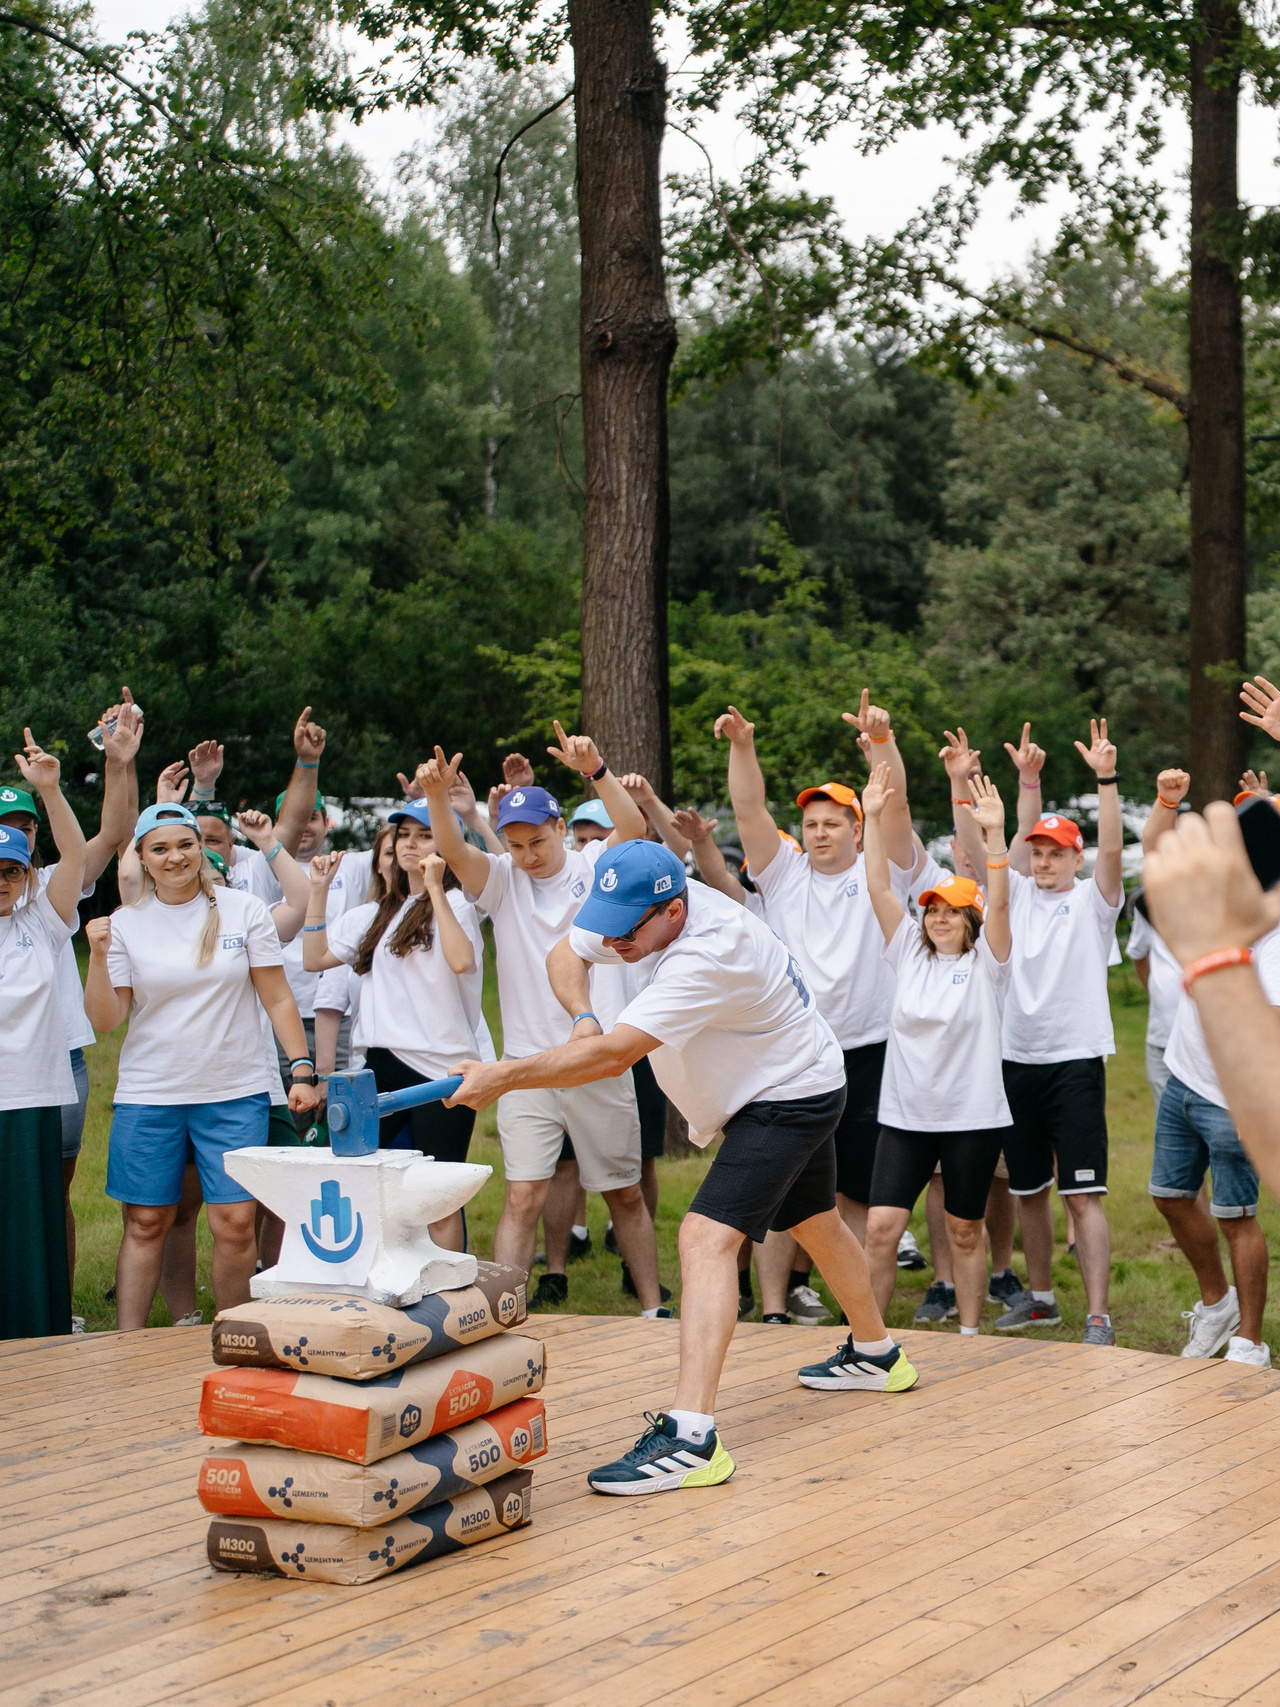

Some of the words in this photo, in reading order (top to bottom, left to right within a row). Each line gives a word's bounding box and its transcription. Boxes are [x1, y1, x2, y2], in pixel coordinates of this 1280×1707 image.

[501, 1297, 515, 1312] 40
[397, 1336, 428, 1350] ЦЕМЕНТУМ
[307, 1349, 347, 1358] ЦЕМЕНТУМ
[502, 1372, 528, 1387] ЦЕМЕНТУМ
[224, 1391, 256, 1401] ЦЕМЕНТУМ
[449, 1387, 481, 1415] 500
[402, 1410, 419, 1426] 40
[464, 1437, 494, 1454] EXTRACEM
[513, 1432, 528, 1448] 40
[468, 1444, 501, 1473] 500
[206, 1468, 241, 1486] 500
[291, 1489, 329, 1498] ЦЕМЕНТУМ
[399, 1481, 429, 1496] ЦЕМЕНТУМ
[506, 1498, 520, 1513] 40
[395, 1537, 428, 1553] ЦЕМЕНТУМ
[304, 1555, 344, 1564] ЦЕМЕНТУМ
